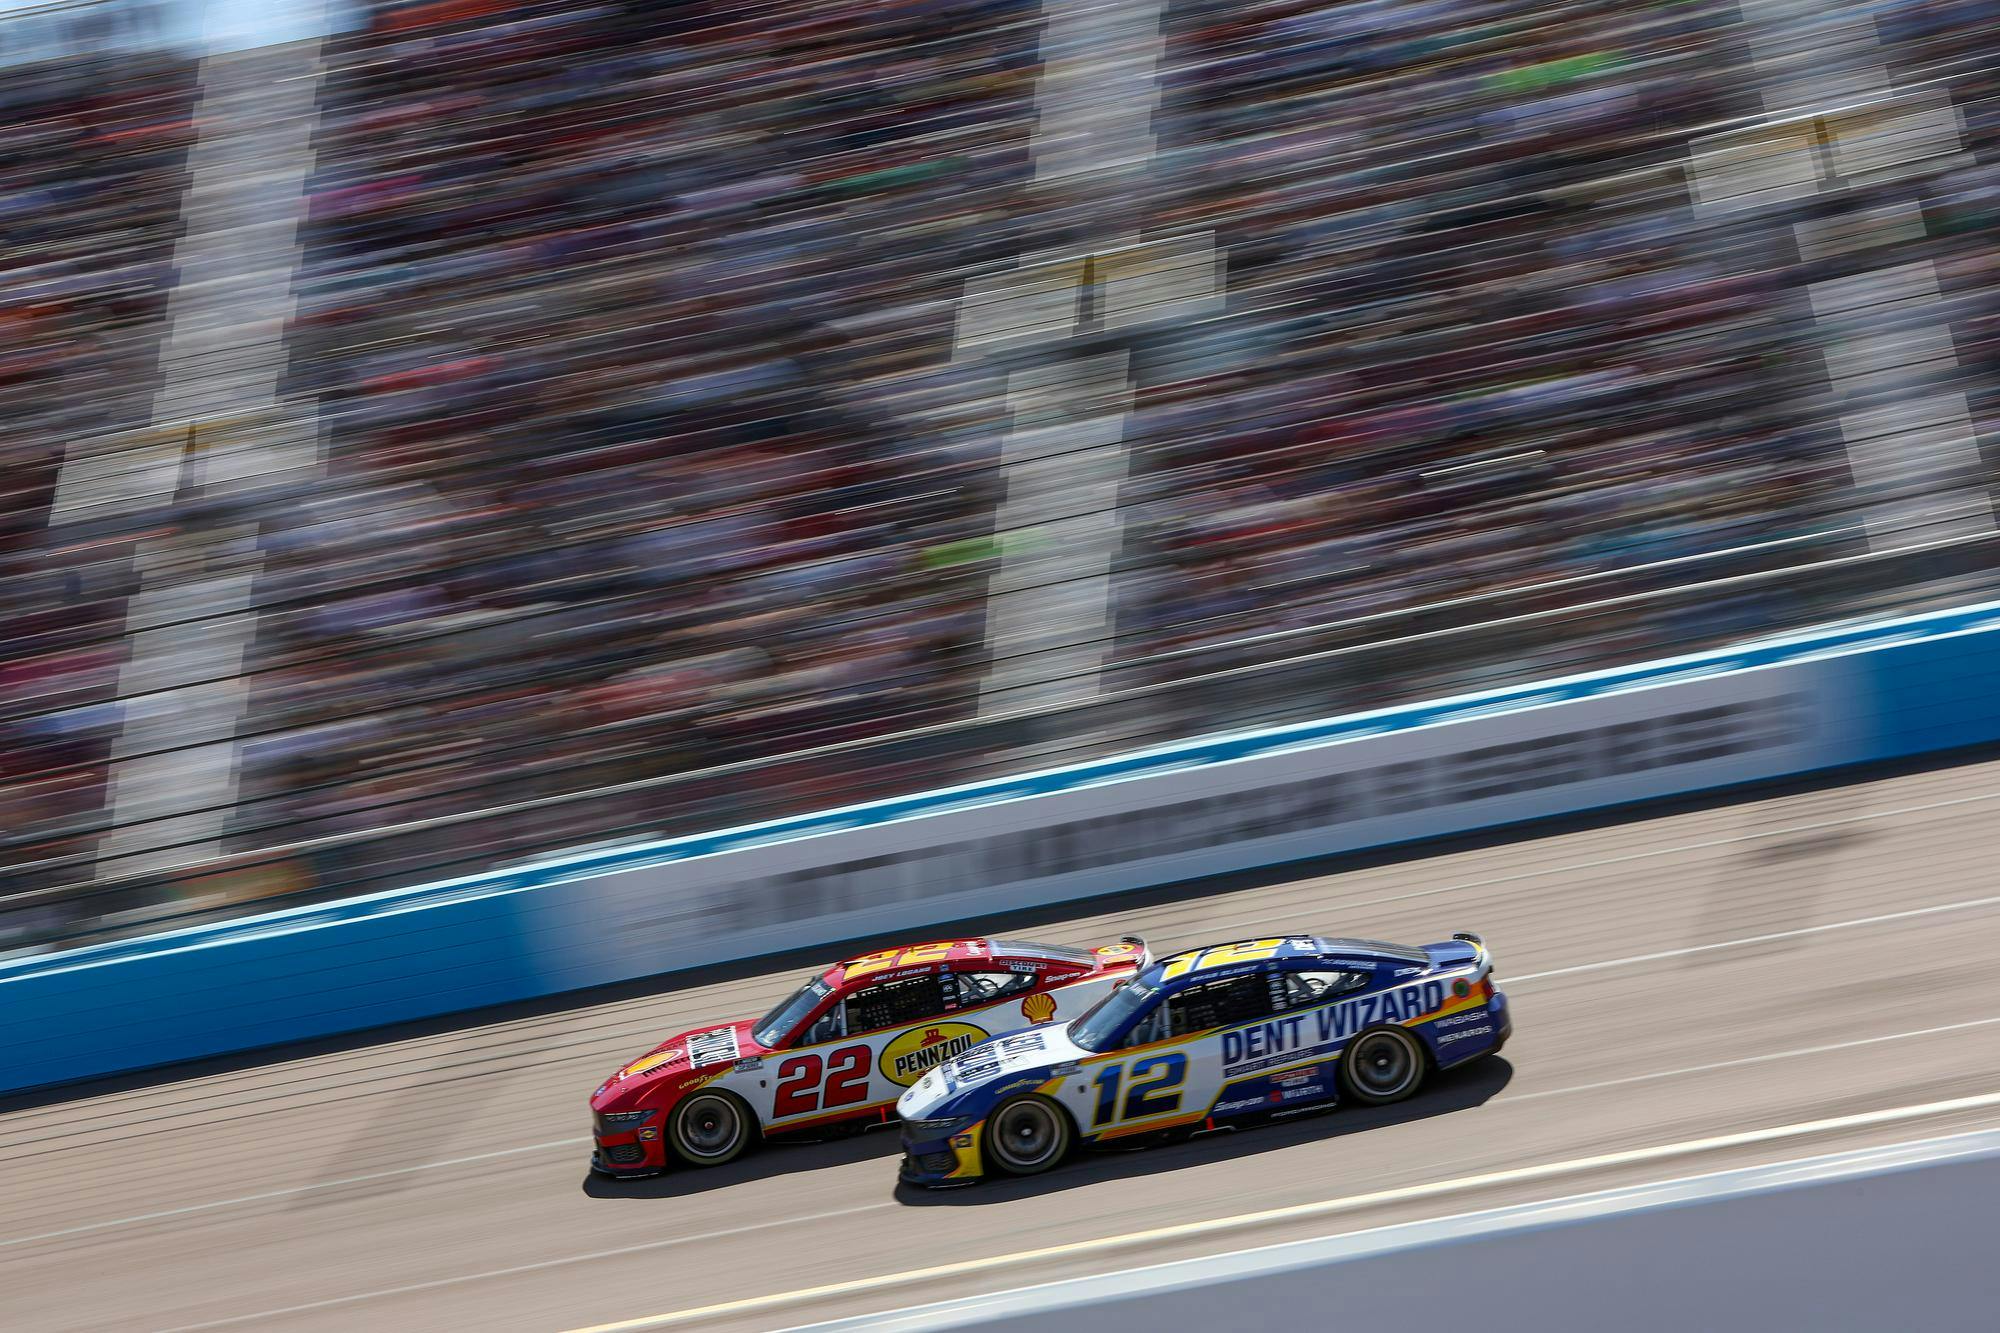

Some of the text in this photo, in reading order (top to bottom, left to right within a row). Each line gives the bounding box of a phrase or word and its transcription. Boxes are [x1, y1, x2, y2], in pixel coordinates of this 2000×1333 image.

[872, 966, 932, 982] JOEY LOGANO
[999, 959, 1048, 970] DISCOUNT
[1012, 964, 1034, 972] TIRE
[1222, 1016, 1308, 1066] DENT
[1317, 979, 1445, 1042] WIZARD
[773, 1044, 873, 1119] 22
[1091, 1050, 1189, 1128] 12
